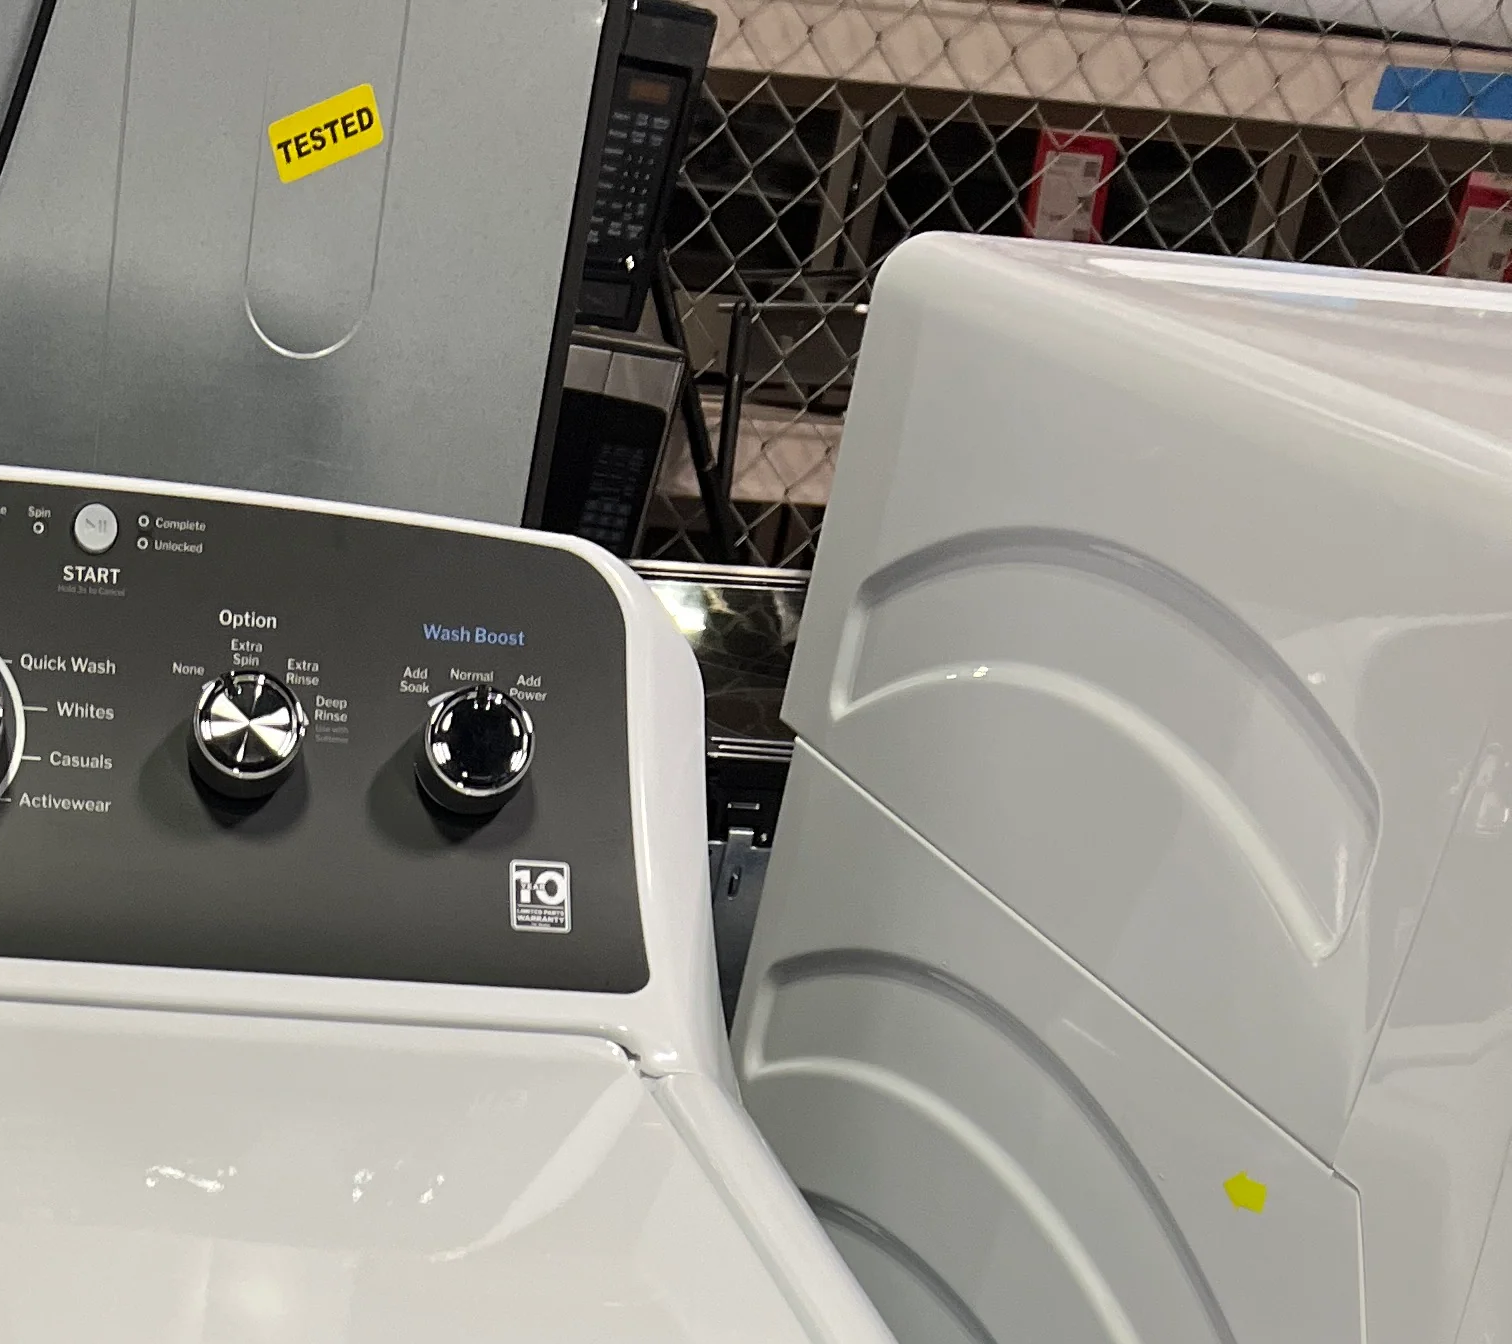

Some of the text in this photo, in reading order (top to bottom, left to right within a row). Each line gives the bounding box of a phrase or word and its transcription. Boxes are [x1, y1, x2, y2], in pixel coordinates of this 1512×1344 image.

[277, 106, 374, 164] TESTED
[28, 506, 52, 519] Spin
[155, 517, 207, 532] Complete
[154, 539, 204, 554] Unlocked
[63, 565, 121, 584] START
[219, 609, 277, 629] Option
[423, 623, 525, 646] Wash Boost
[230, 638, 263, 653] Extra
[20, 653, 116, 675] Quick Wash
[233, 653, 260, 667] Spin
[287, 658, 320, 673] Extra
[172, 661, 205, 677] None
[403, 666, 428, 680] Add
[450, 667, 494, 682] Normal
[286, 672, 320, 686] Rinse
[516, 674, 542, 688] Add
[399, 680, 430, 694] Soak
[509, 687, 548, 702] Power
[315, 694, 348, 711] Deep
[56, 701, 115, 720] Whites
[314, 708, 348, 723] Rinse
[49, 751, 113, 770] Casuals
[19, 792, 112, 813] Activewear
[514, 869, 566, 905] 10
[516, 915, 565, 923] WARRANTY
